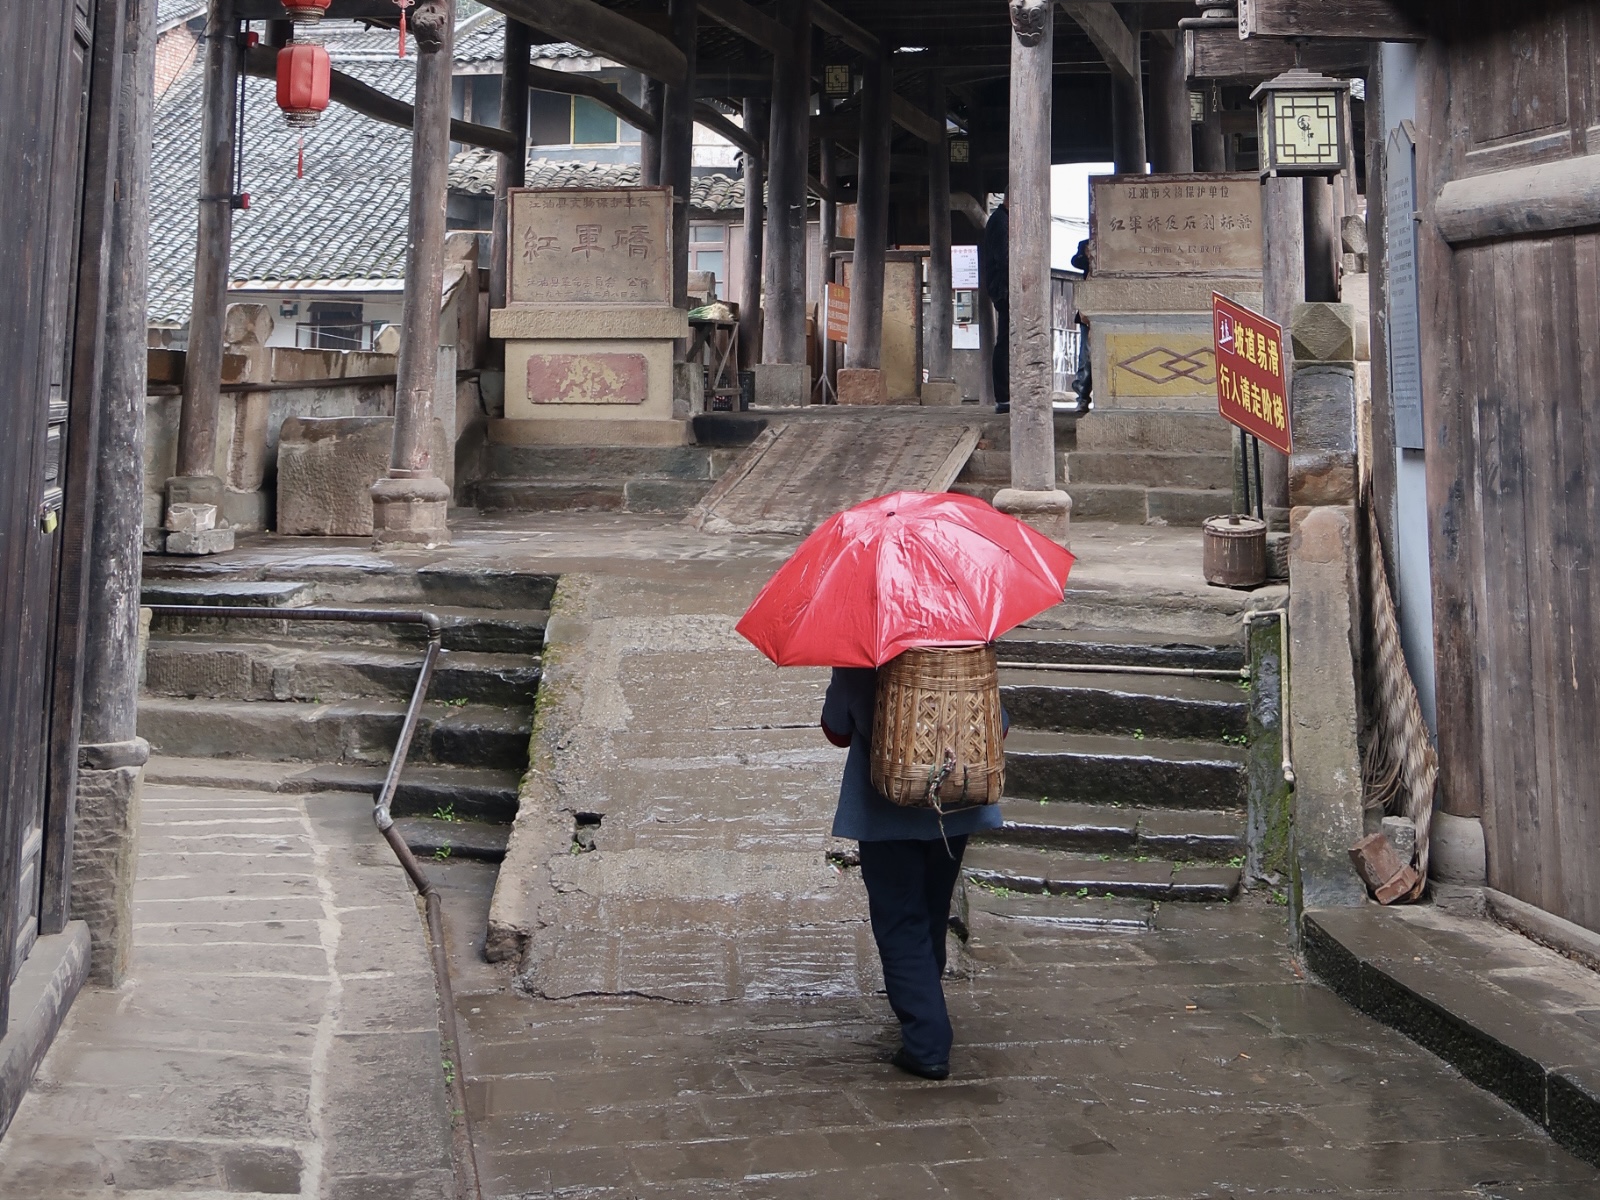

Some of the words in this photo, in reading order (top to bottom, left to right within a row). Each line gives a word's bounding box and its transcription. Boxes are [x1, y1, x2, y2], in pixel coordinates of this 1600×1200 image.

[1233, 320, 1280, 378] 坡道易滑
[1219, 363, 1286, 432] 行人请走阶梯
